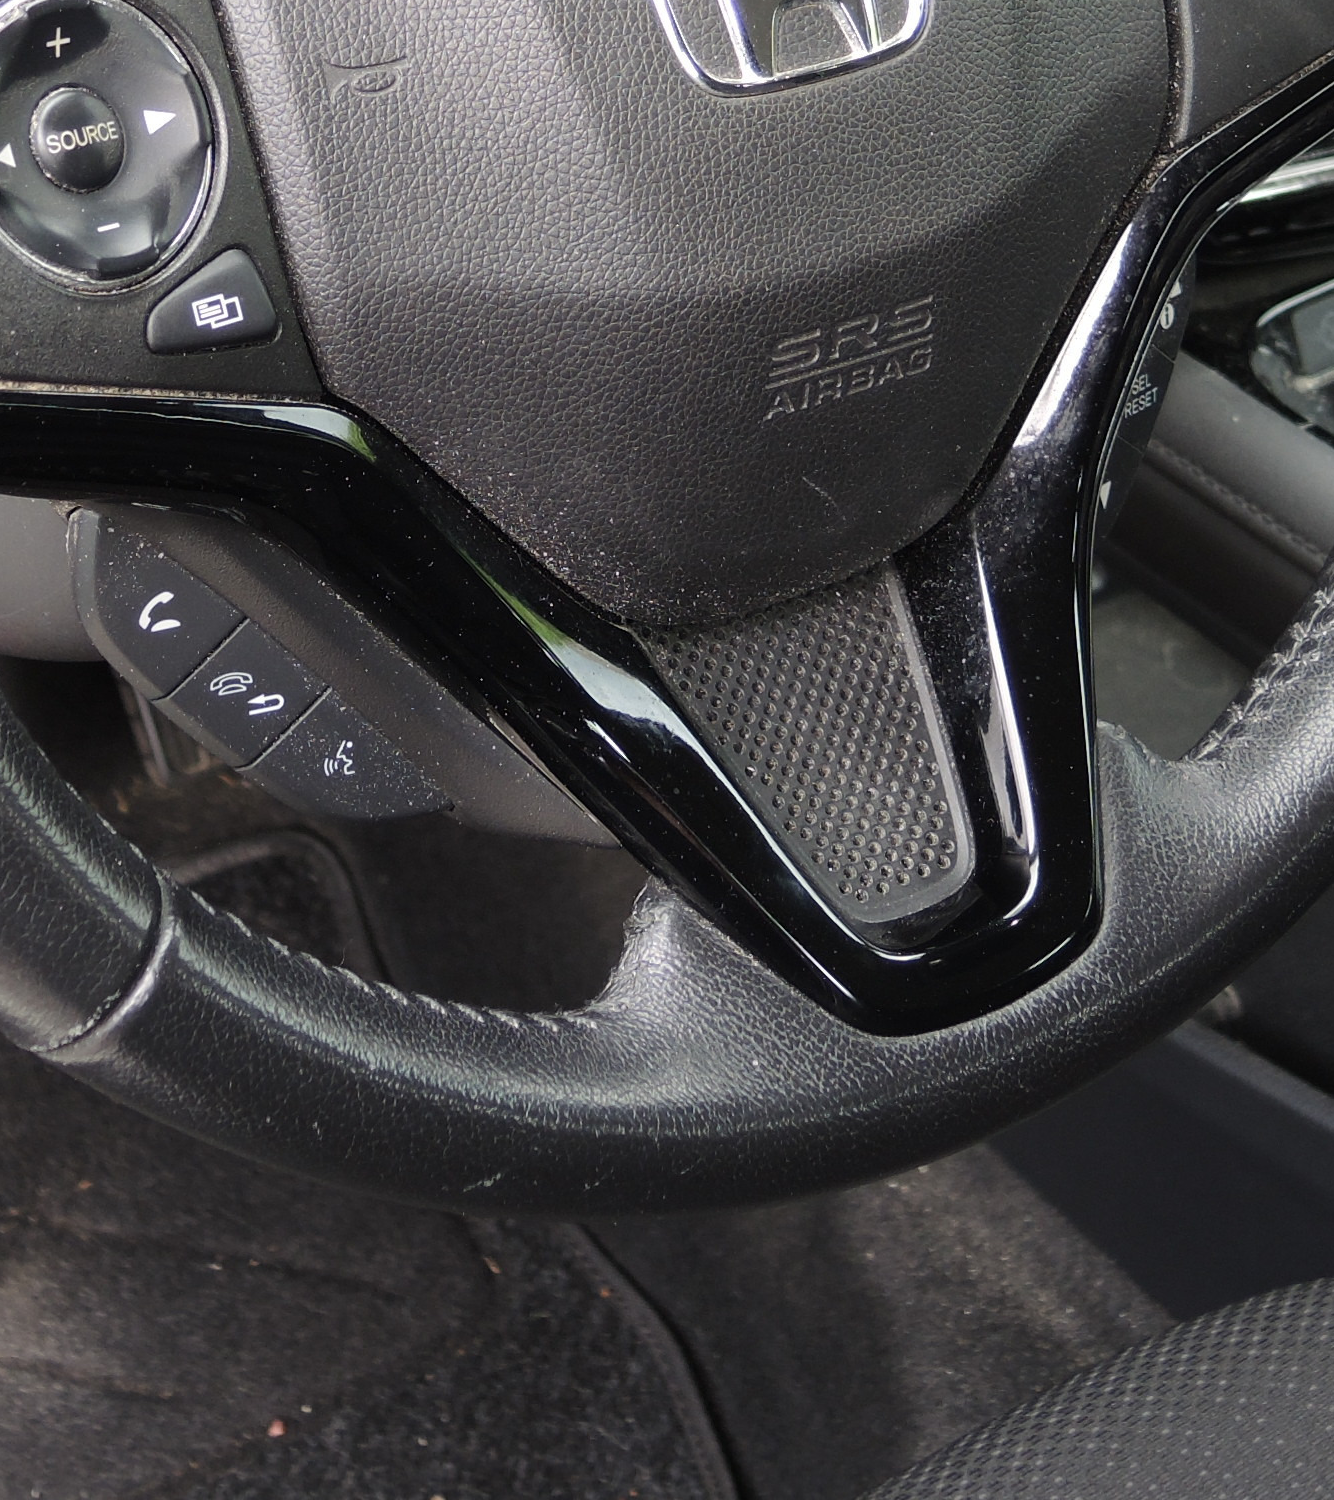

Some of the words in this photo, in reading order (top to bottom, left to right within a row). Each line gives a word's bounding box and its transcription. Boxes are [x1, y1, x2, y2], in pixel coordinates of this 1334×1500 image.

[46, 120, 119, 154] SOURCE
[768, 295, 934, 377] SRS
[763, 346, 934, 421] AIRBAG
[1131, 373, 1152, 395] SEL
[1124, 386, 1158, 419] RESET
